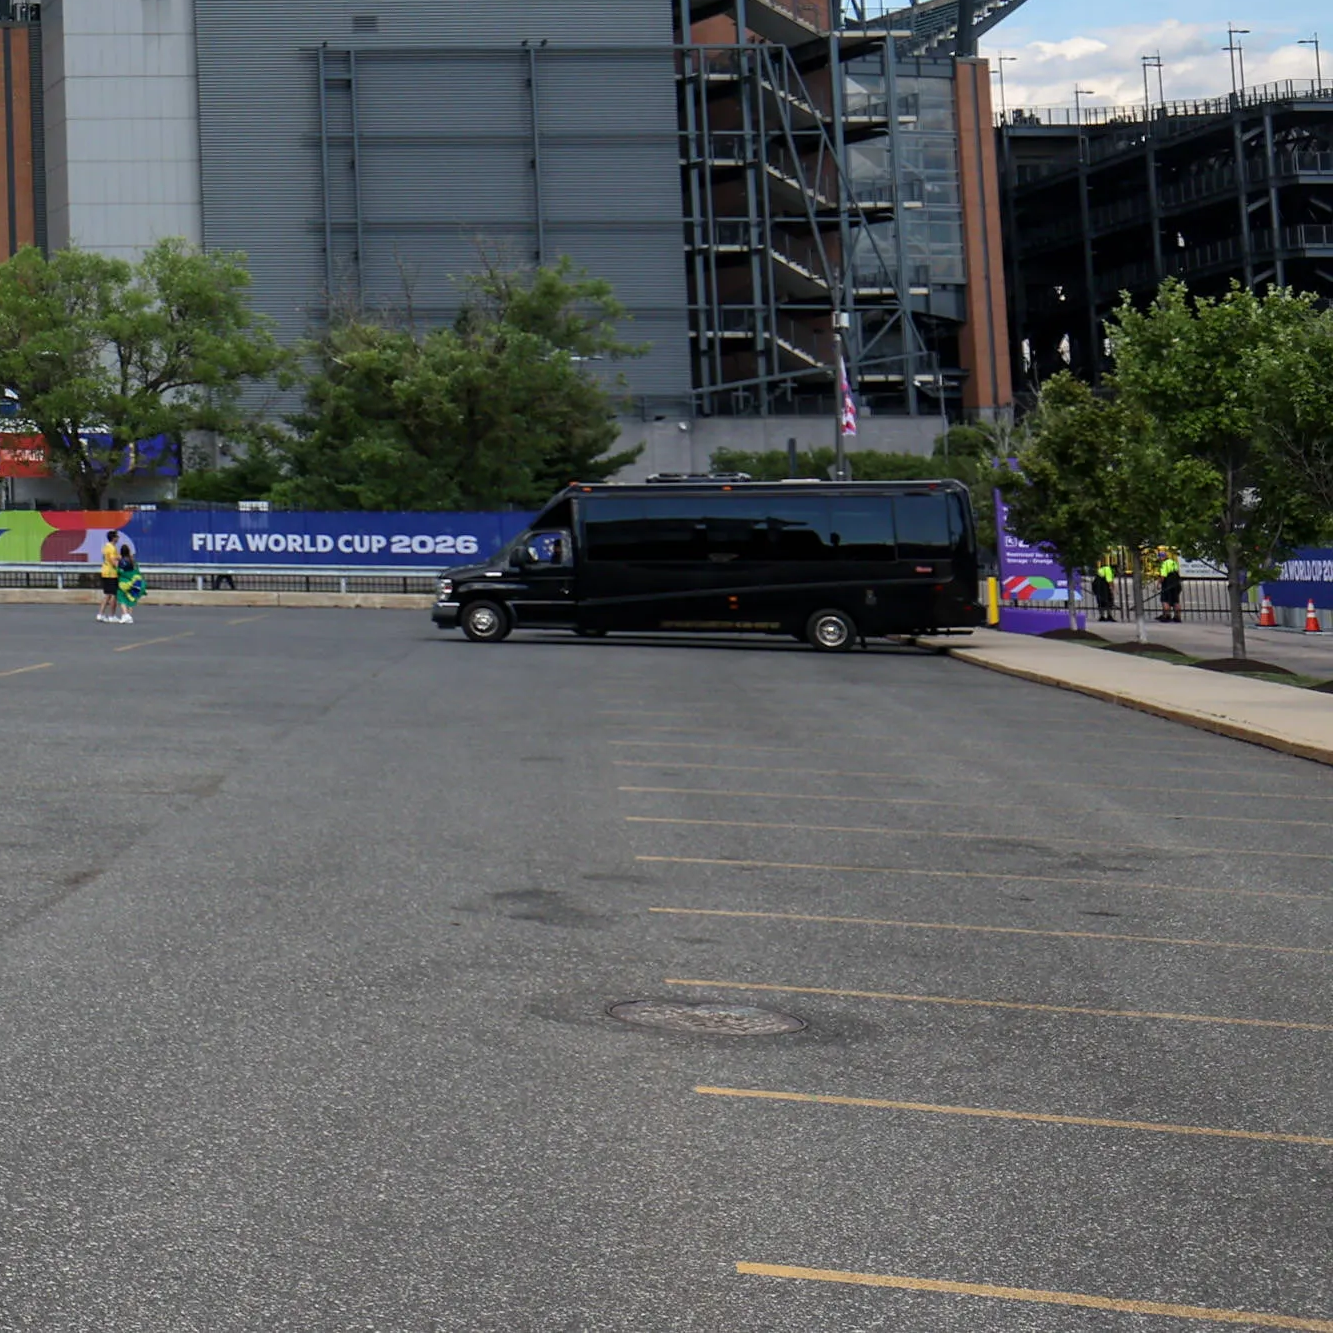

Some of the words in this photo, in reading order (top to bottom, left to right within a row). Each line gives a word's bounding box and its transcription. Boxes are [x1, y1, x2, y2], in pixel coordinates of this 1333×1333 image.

[192, 533, 243, 552] FIFA
[245, 534, 334, 553] WORLD
[338, 535, 387, 553] CUP
[390, 535, 479, 554] 2026
[1288, 561, 1312, 581] WORLD
[1312, 561, 1322, 581] CUP
